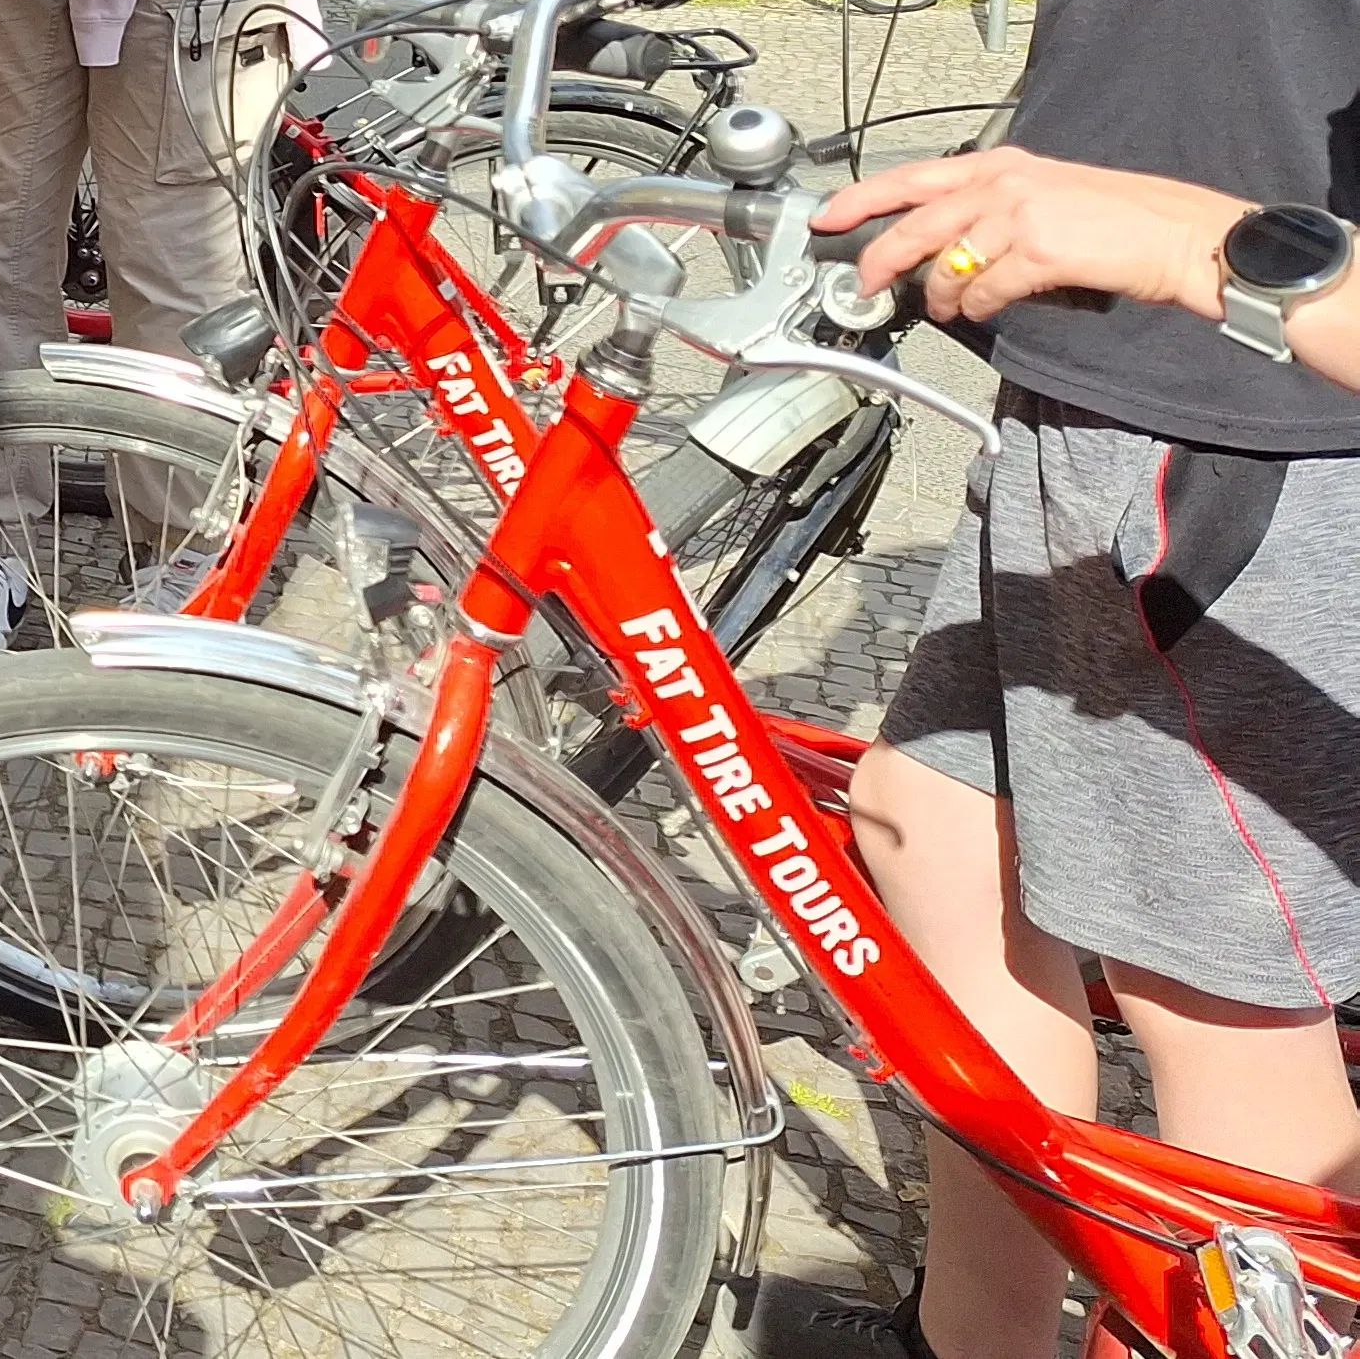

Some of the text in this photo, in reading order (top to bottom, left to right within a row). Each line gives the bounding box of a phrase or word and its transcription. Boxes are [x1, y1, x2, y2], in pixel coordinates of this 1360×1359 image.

[427, 351, 489, 416] FAT
[620, 608, 881, 977] FAT TIRE TOURS
